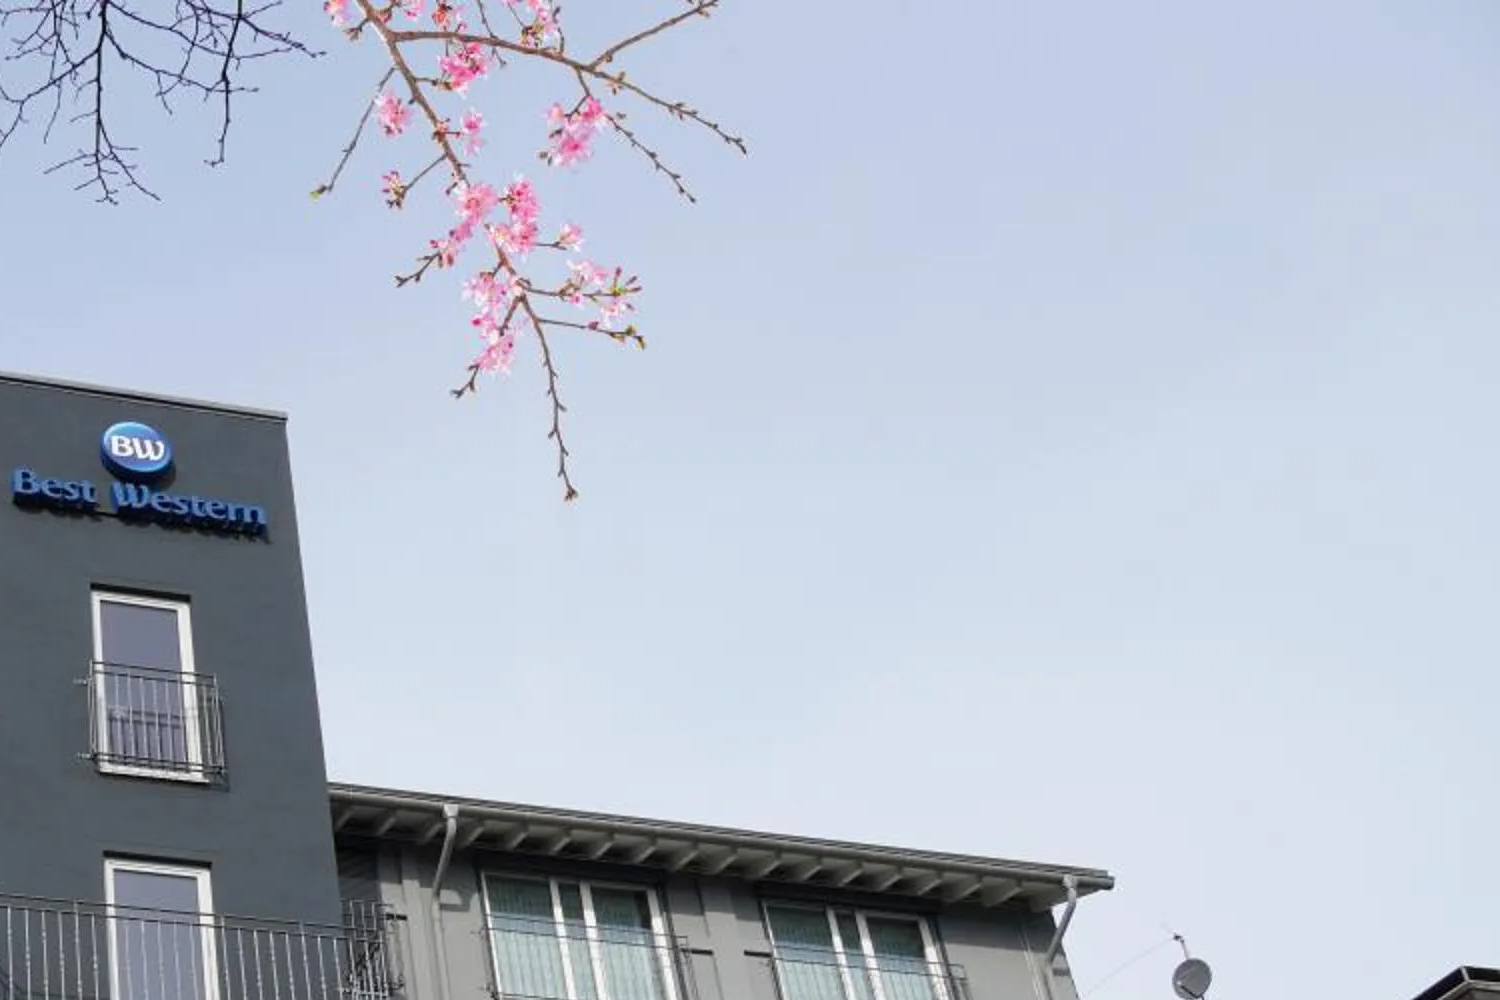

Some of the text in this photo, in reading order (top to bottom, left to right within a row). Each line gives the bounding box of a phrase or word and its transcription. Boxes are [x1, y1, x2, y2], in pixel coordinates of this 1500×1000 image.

[109, 434, 165, 461] BW
[11, 467, 267, 526] Best Western
